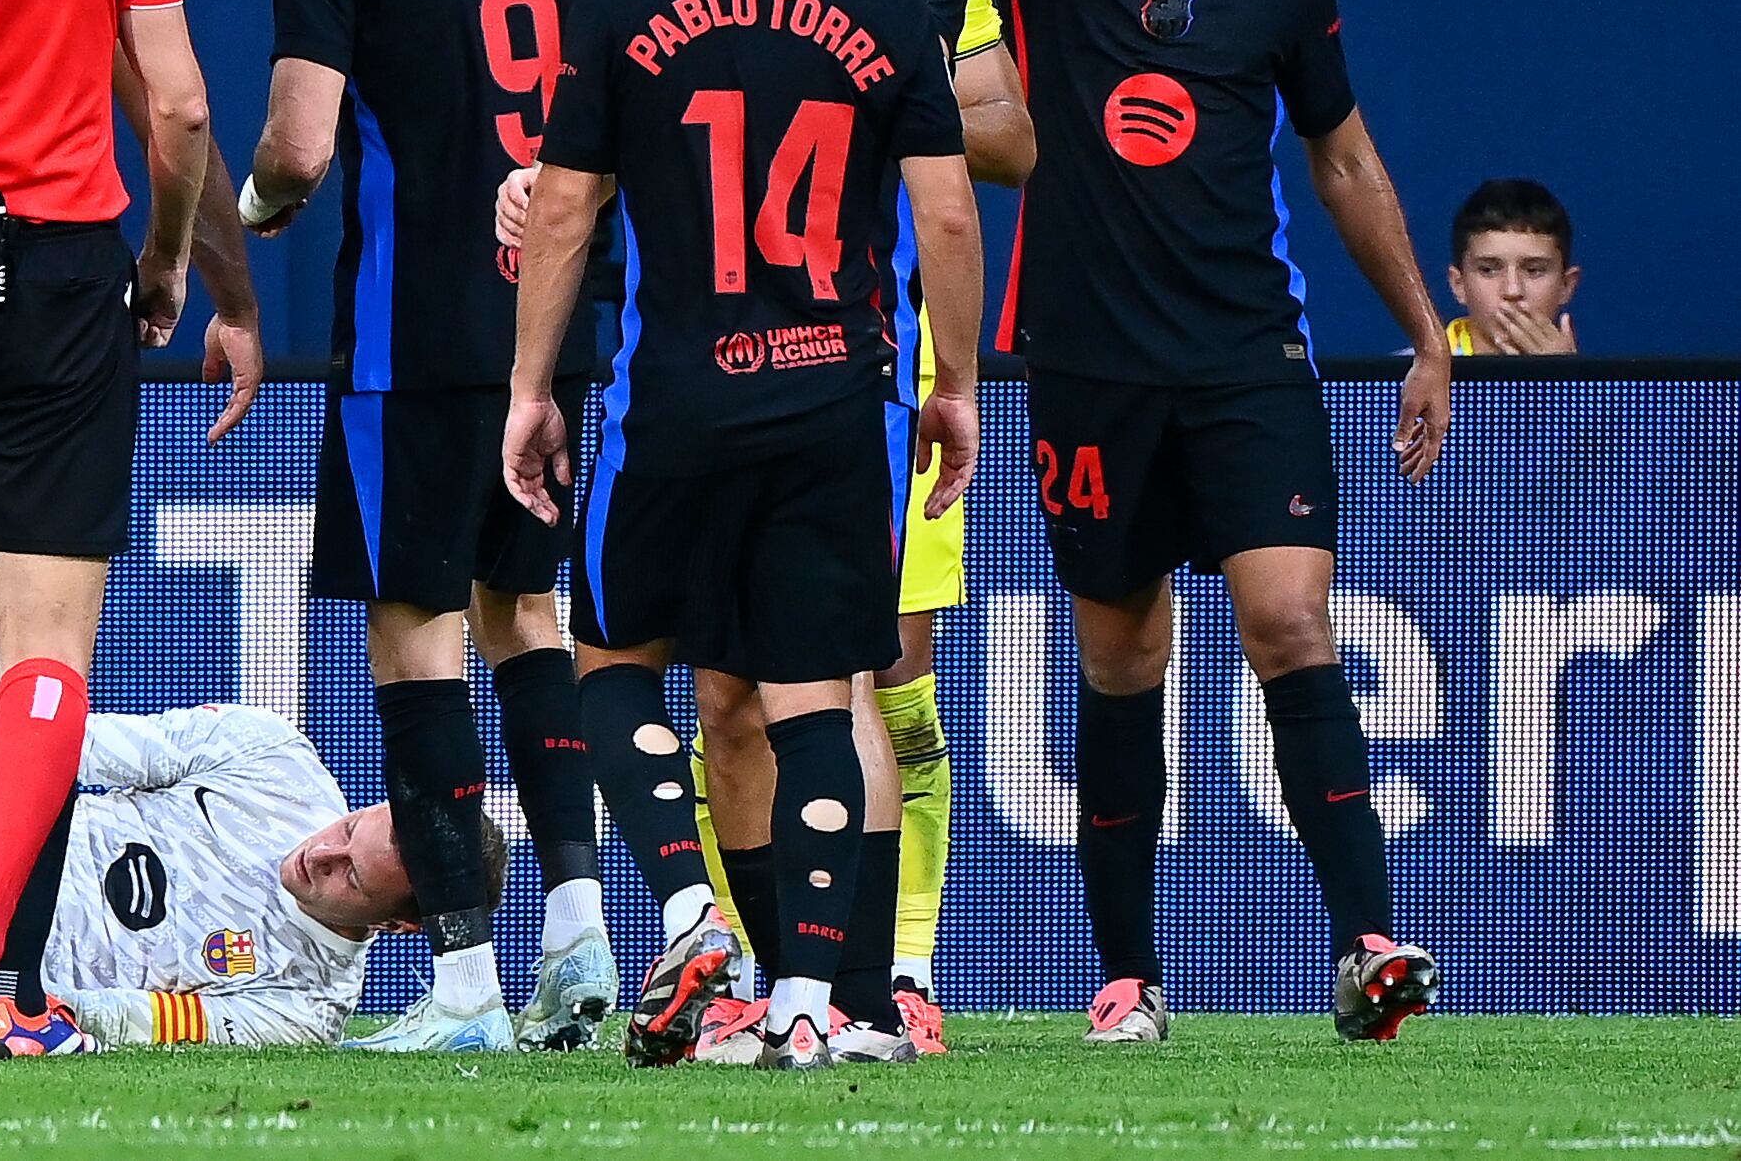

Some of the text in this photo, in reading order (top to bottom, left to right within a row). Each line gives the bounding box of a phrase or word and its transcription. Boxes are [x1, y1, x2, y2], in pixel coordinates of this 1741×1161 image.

[680, 89, 855, 301] 14
[770, 338, 847, 363] ACNUR
[1036, 439, 1110, 520] 24
